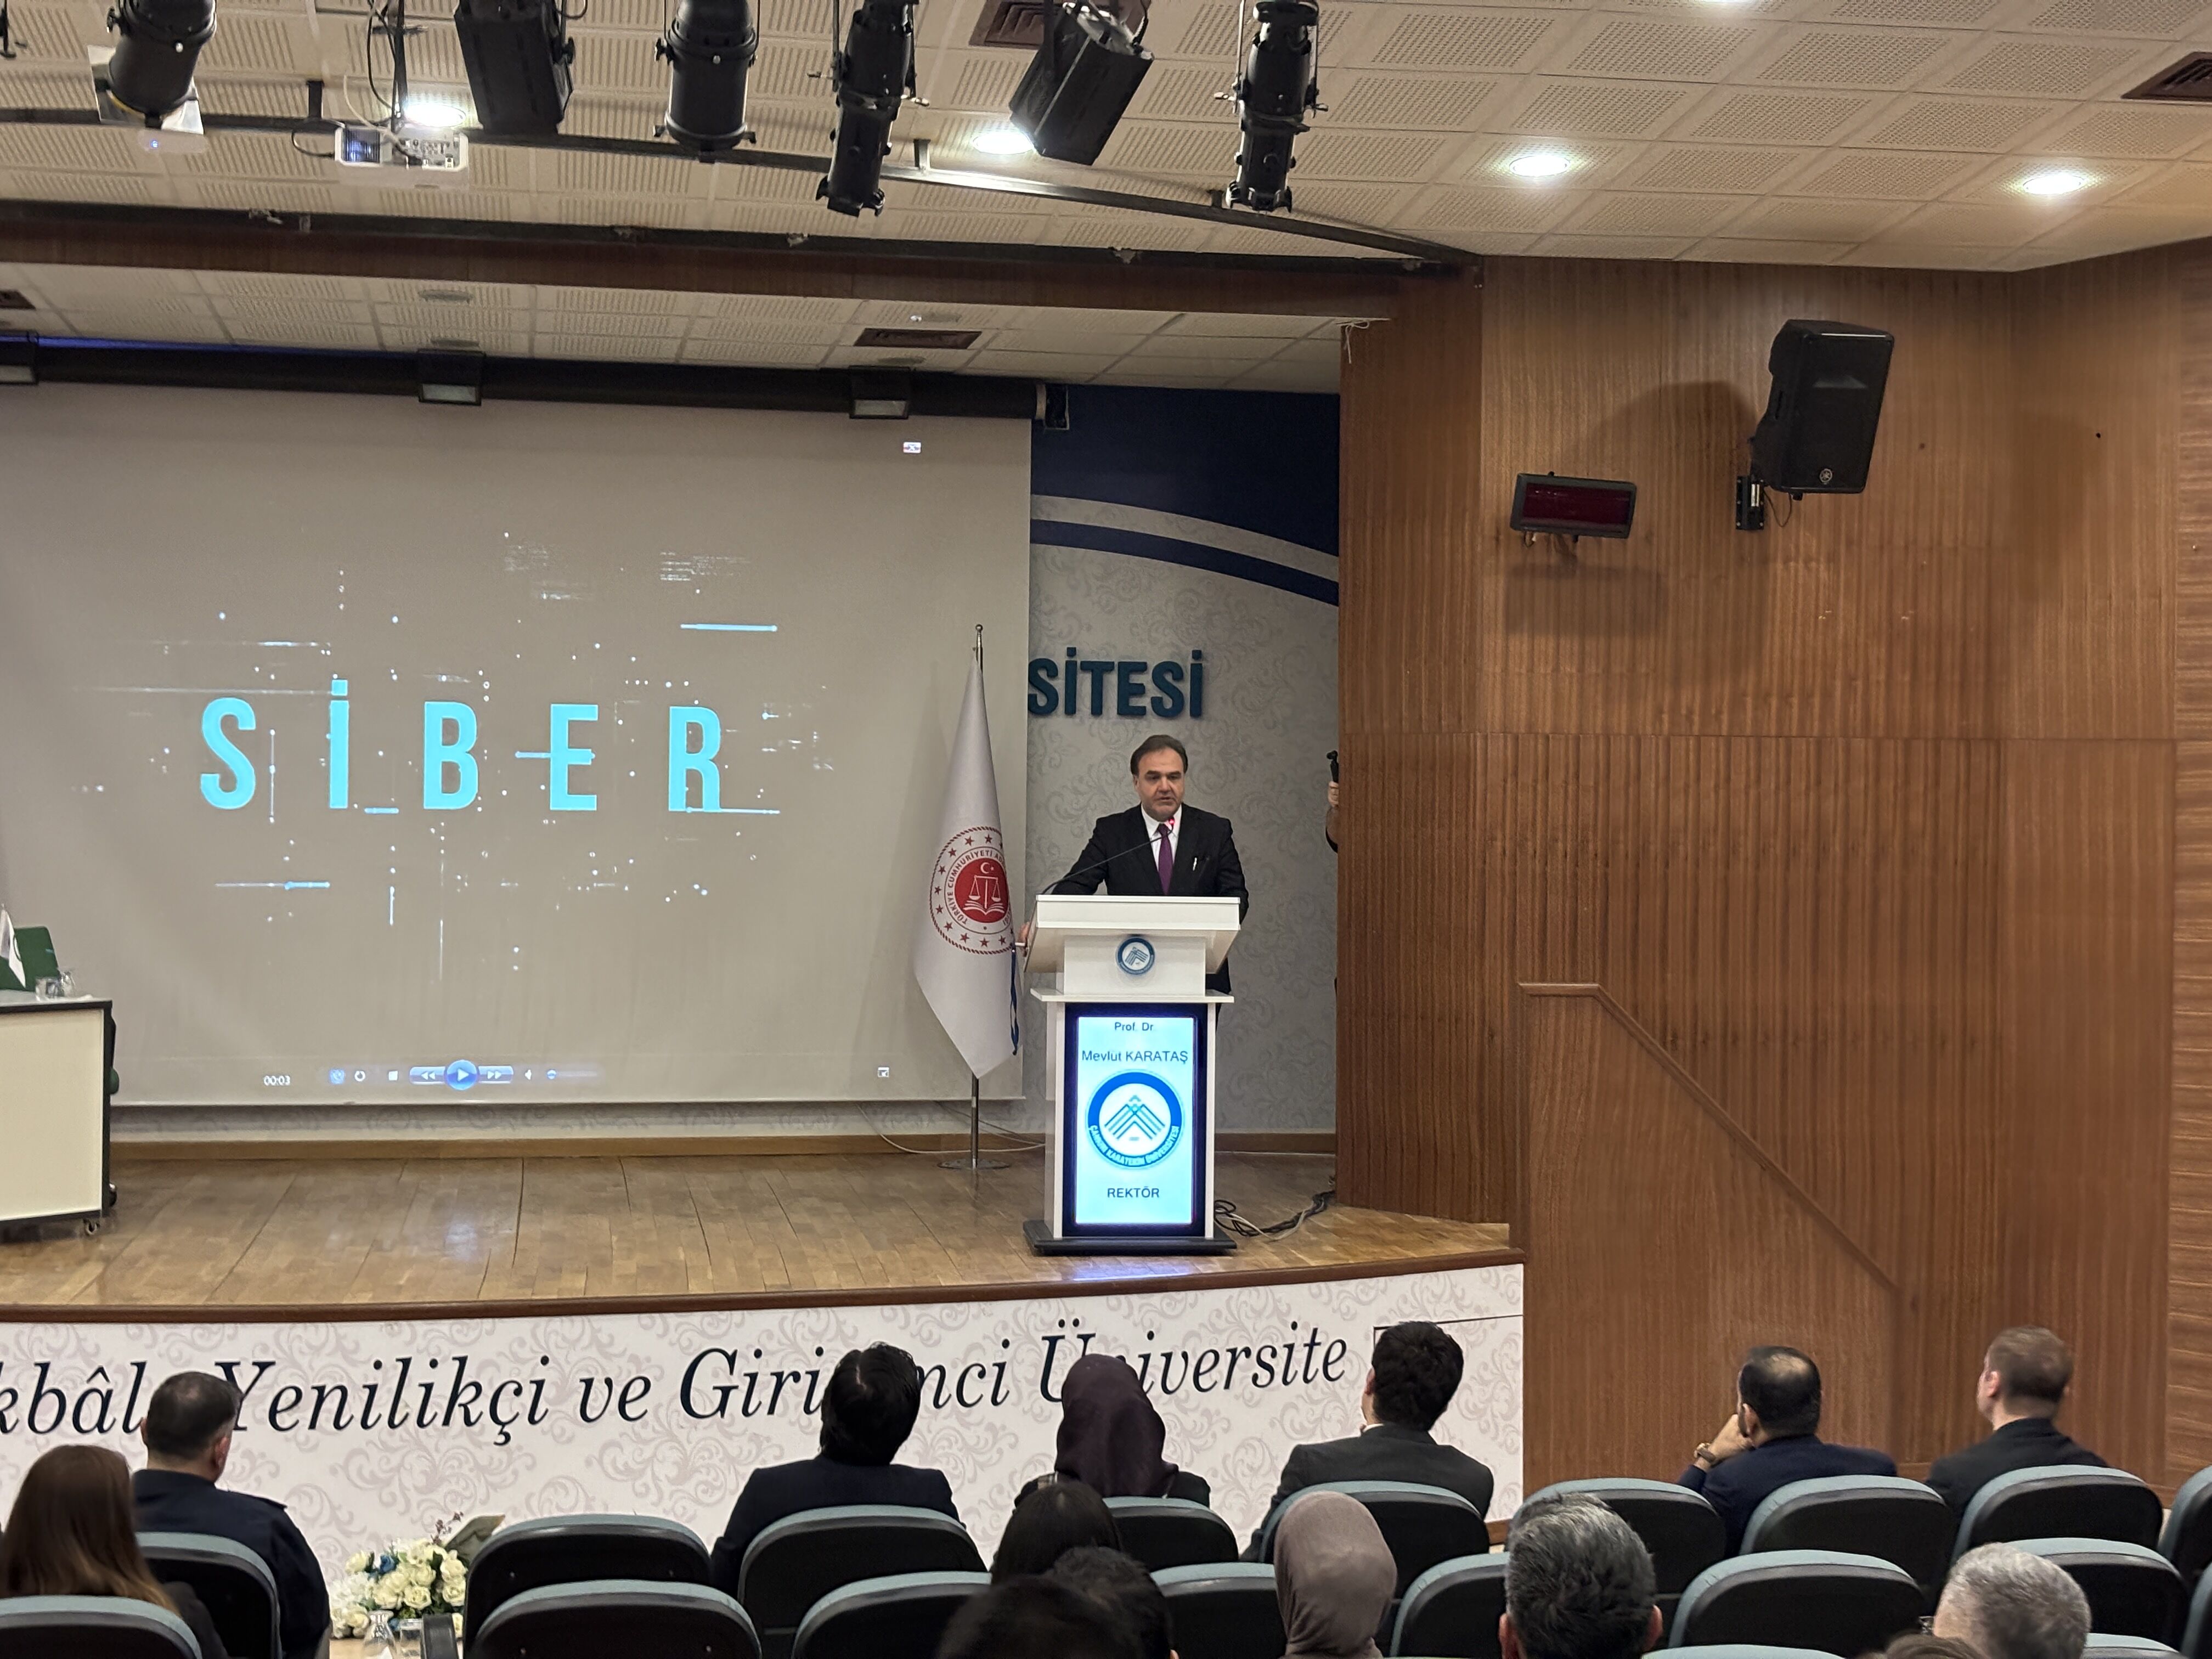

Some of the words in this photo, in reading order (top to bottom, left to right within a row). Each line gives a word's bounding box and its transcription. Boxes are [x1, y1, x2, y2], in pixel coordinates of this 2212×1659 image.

[1028, 647, 1203, 718] SİTESİ
[200, 679, 722, 812] SİBER
[1126, 1050, 1189, 1065] KARATAŞ
[1107, 1186, 1160, 1199] REKTÖR
[215, 1356, 549, 1445] Yenilikçi
[579, 1373, 651, 1422] ve
[1040, 1318, 1347, 1403] Üiversite
